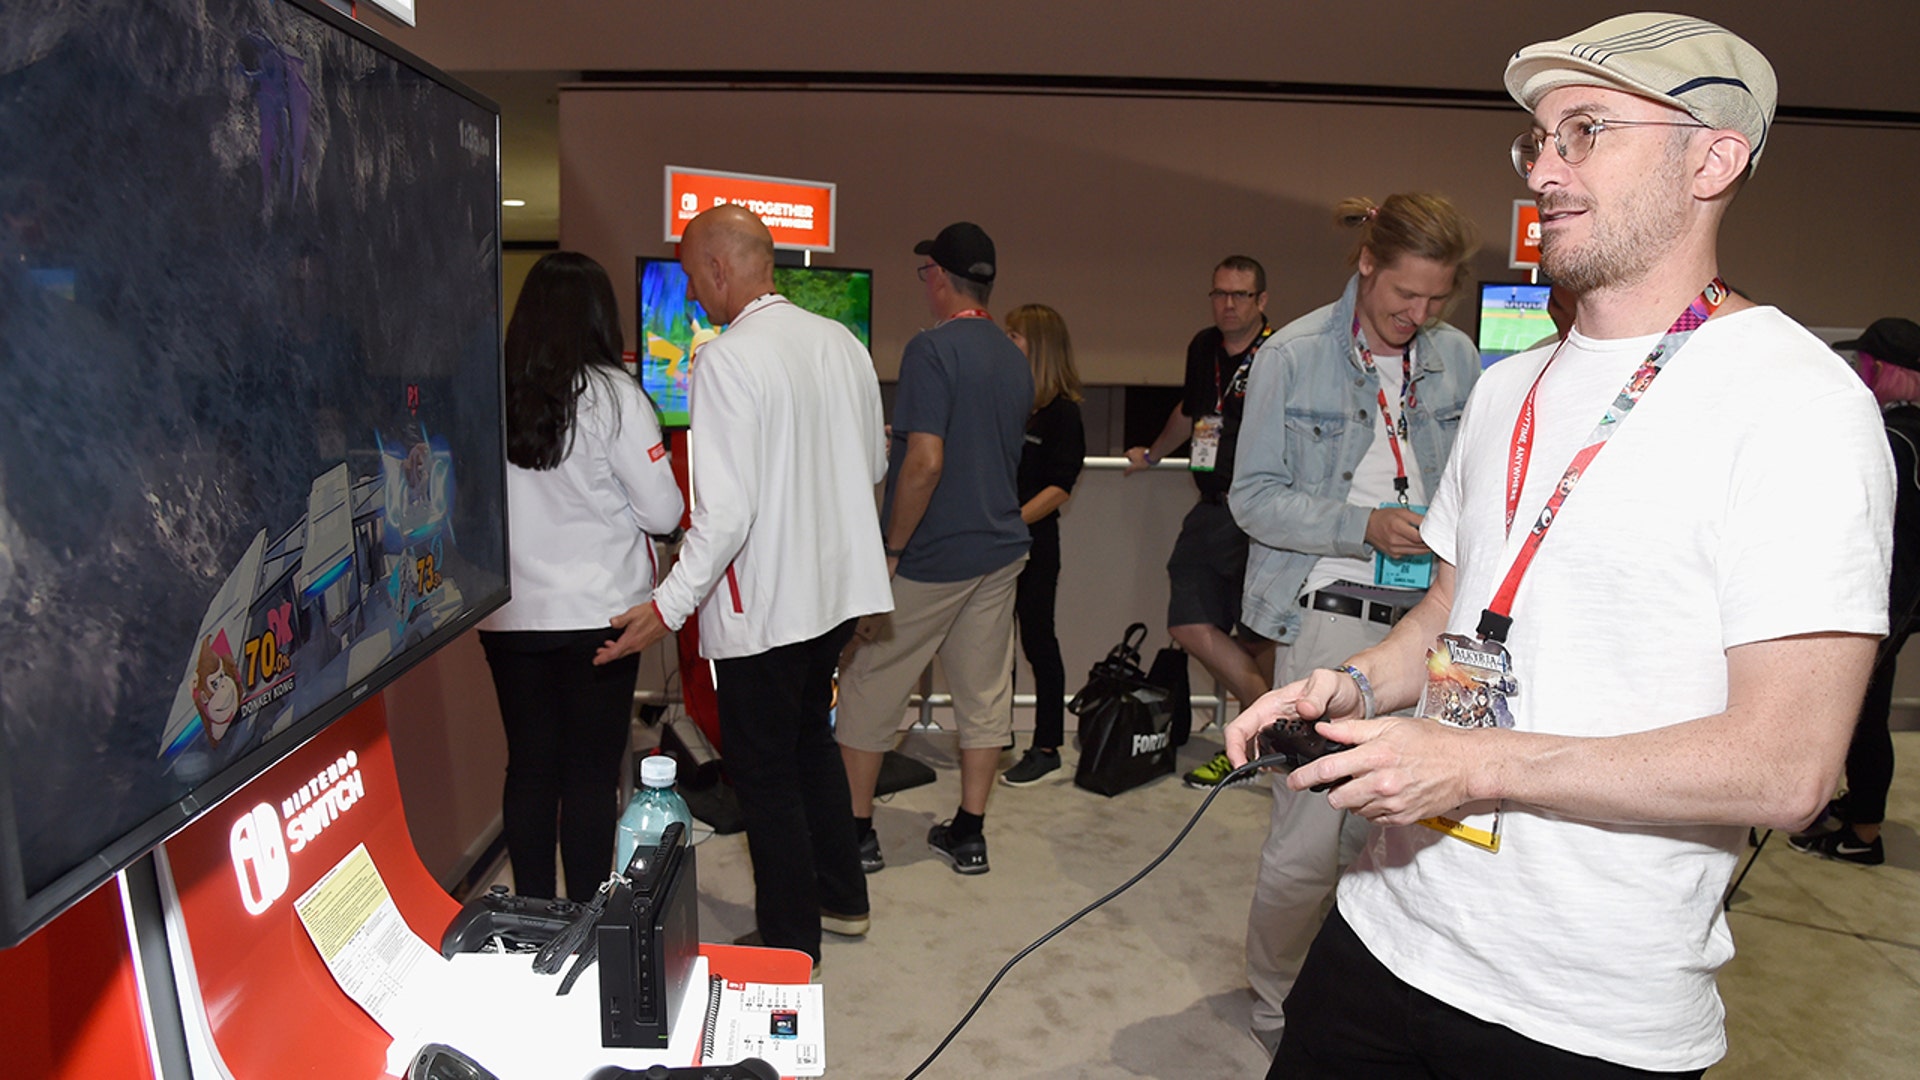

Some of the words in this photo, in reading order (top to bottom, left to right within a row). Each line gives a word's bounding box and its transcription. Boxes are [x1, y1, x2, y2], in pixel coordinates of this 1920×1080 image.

[748, 200, 814, 218] TOGETHER
[240, 691, 273, 717] DONKEY
[273, 678, 295, 701] KONG
[282, 750, 358, 819] NINTENDO
[286, 769, 365, 854] SWITCH
